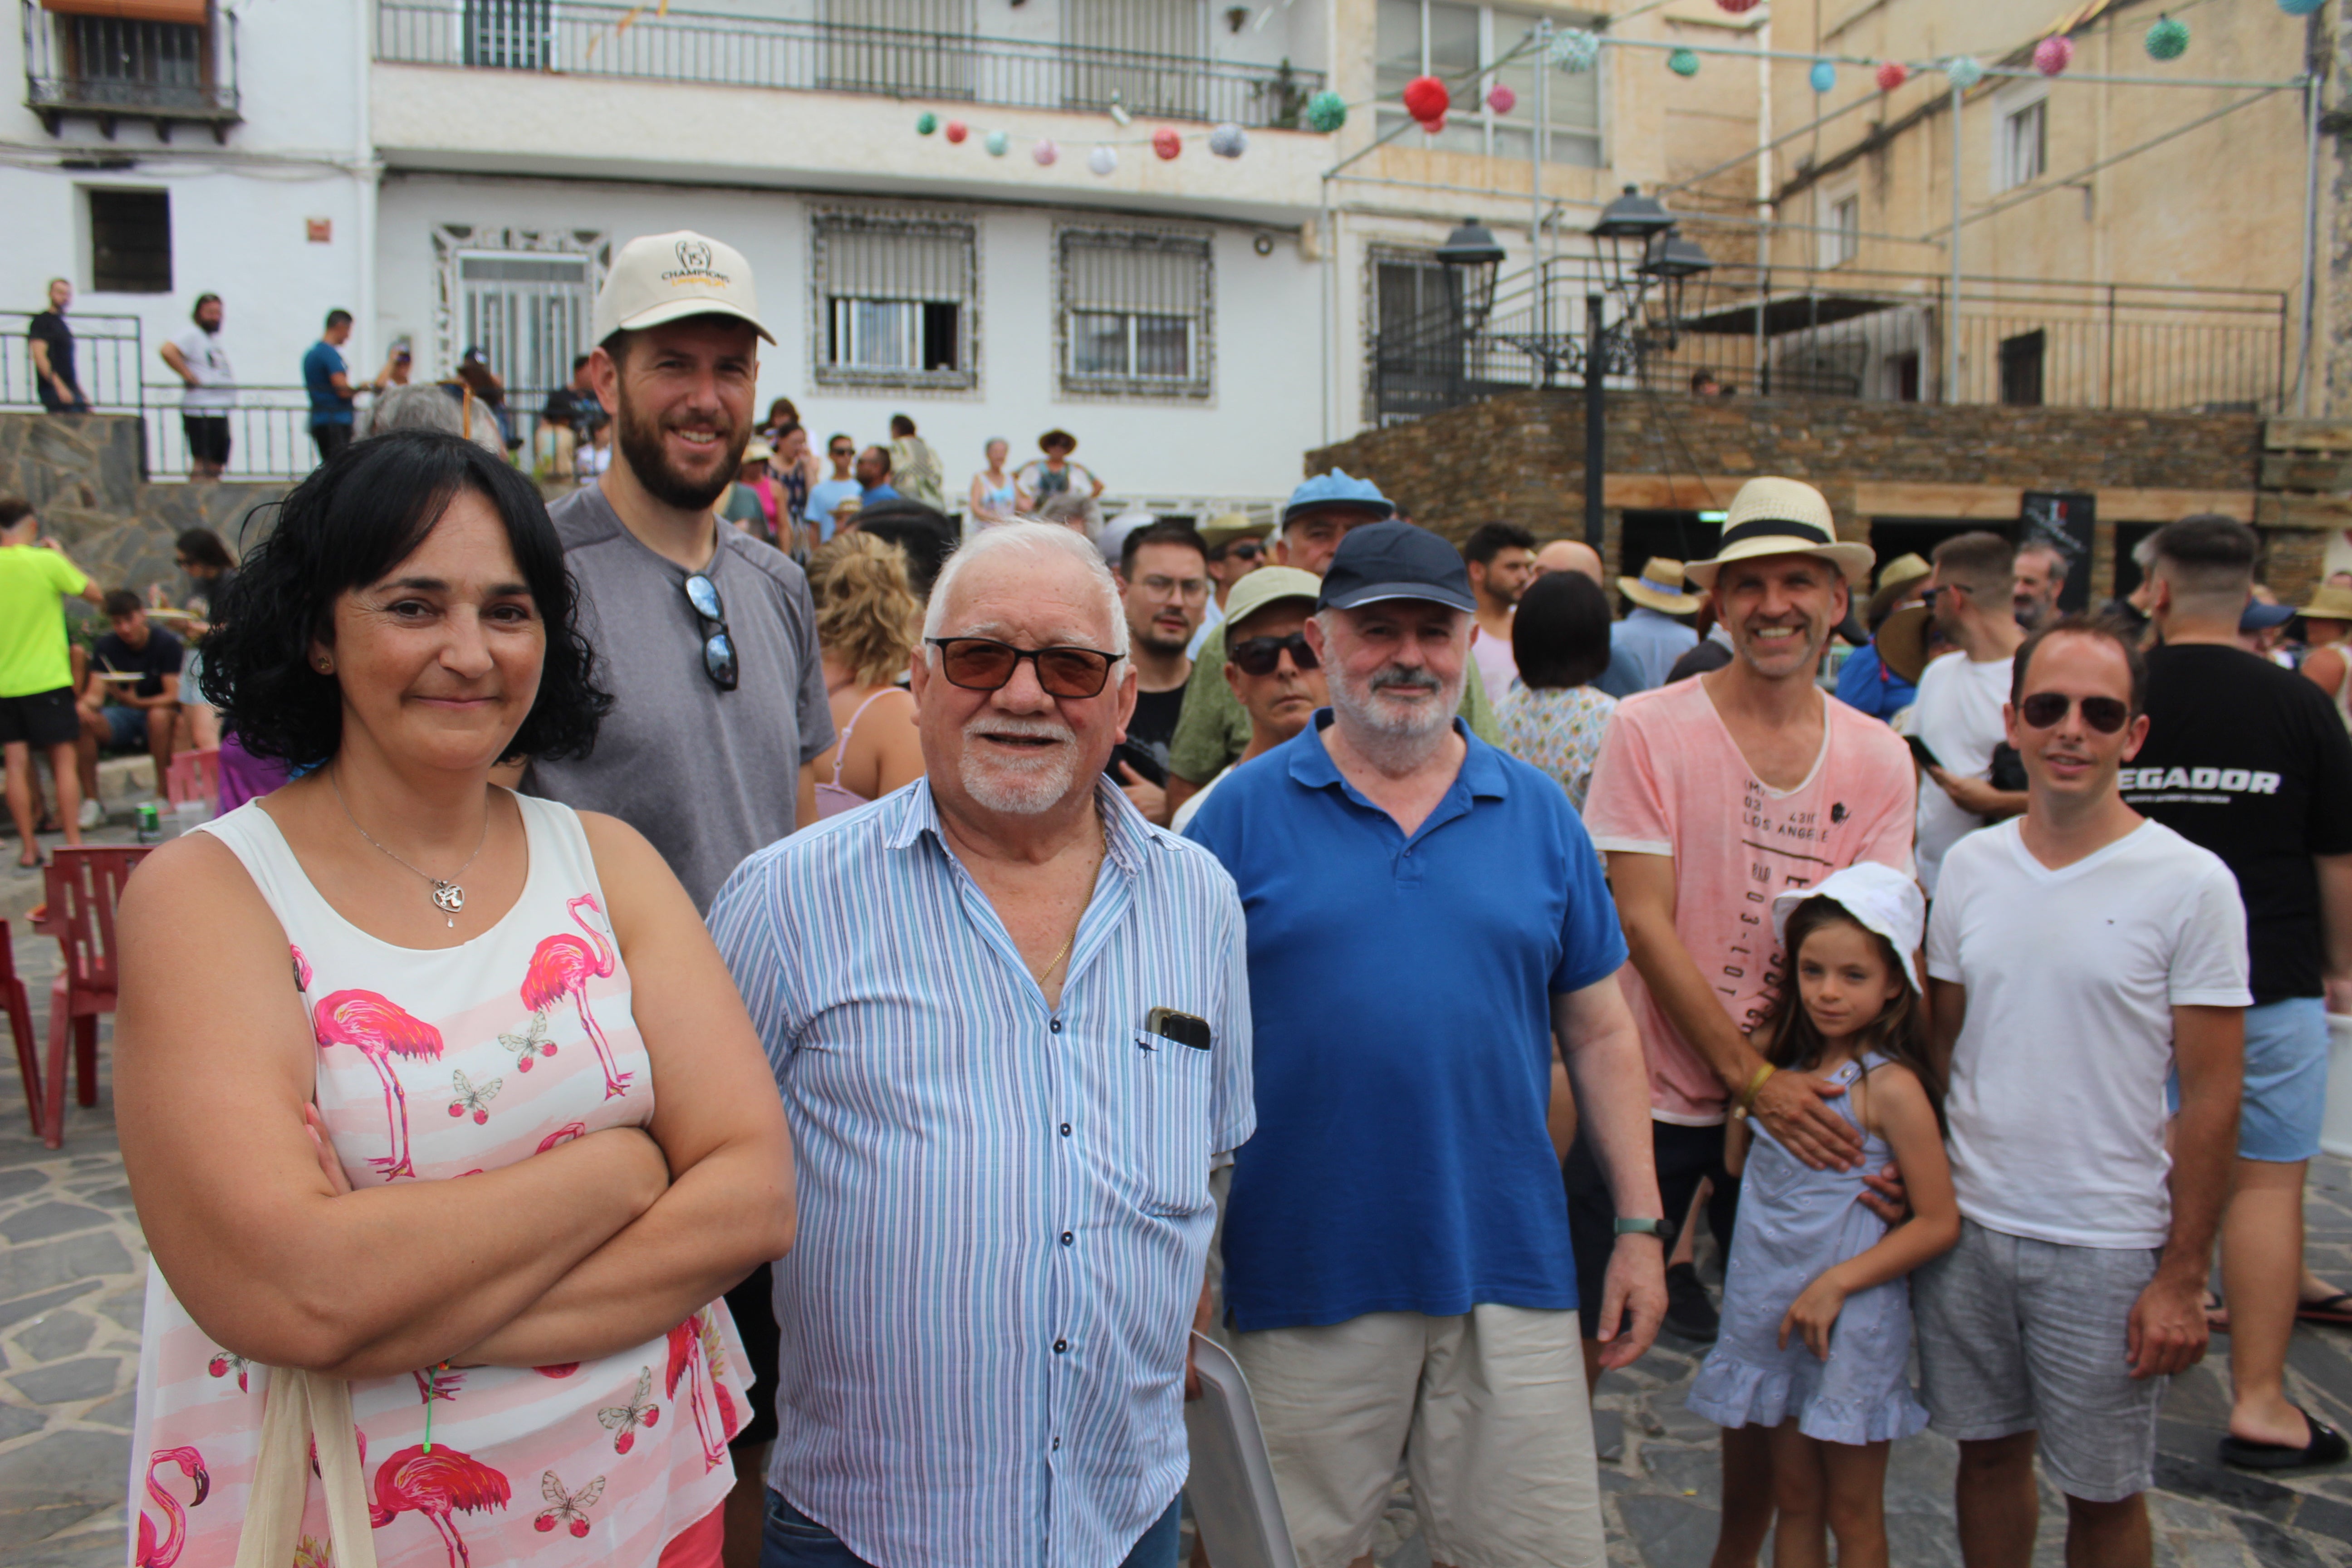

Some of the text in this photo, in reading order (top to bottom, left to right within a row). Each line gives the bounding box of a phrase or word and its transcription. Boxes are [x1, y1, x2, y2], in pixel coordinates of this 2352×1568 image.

[661, 268, 730, 283] CHAMPIONS
[1743, 811, 1828, 843] LOS ANGEE
